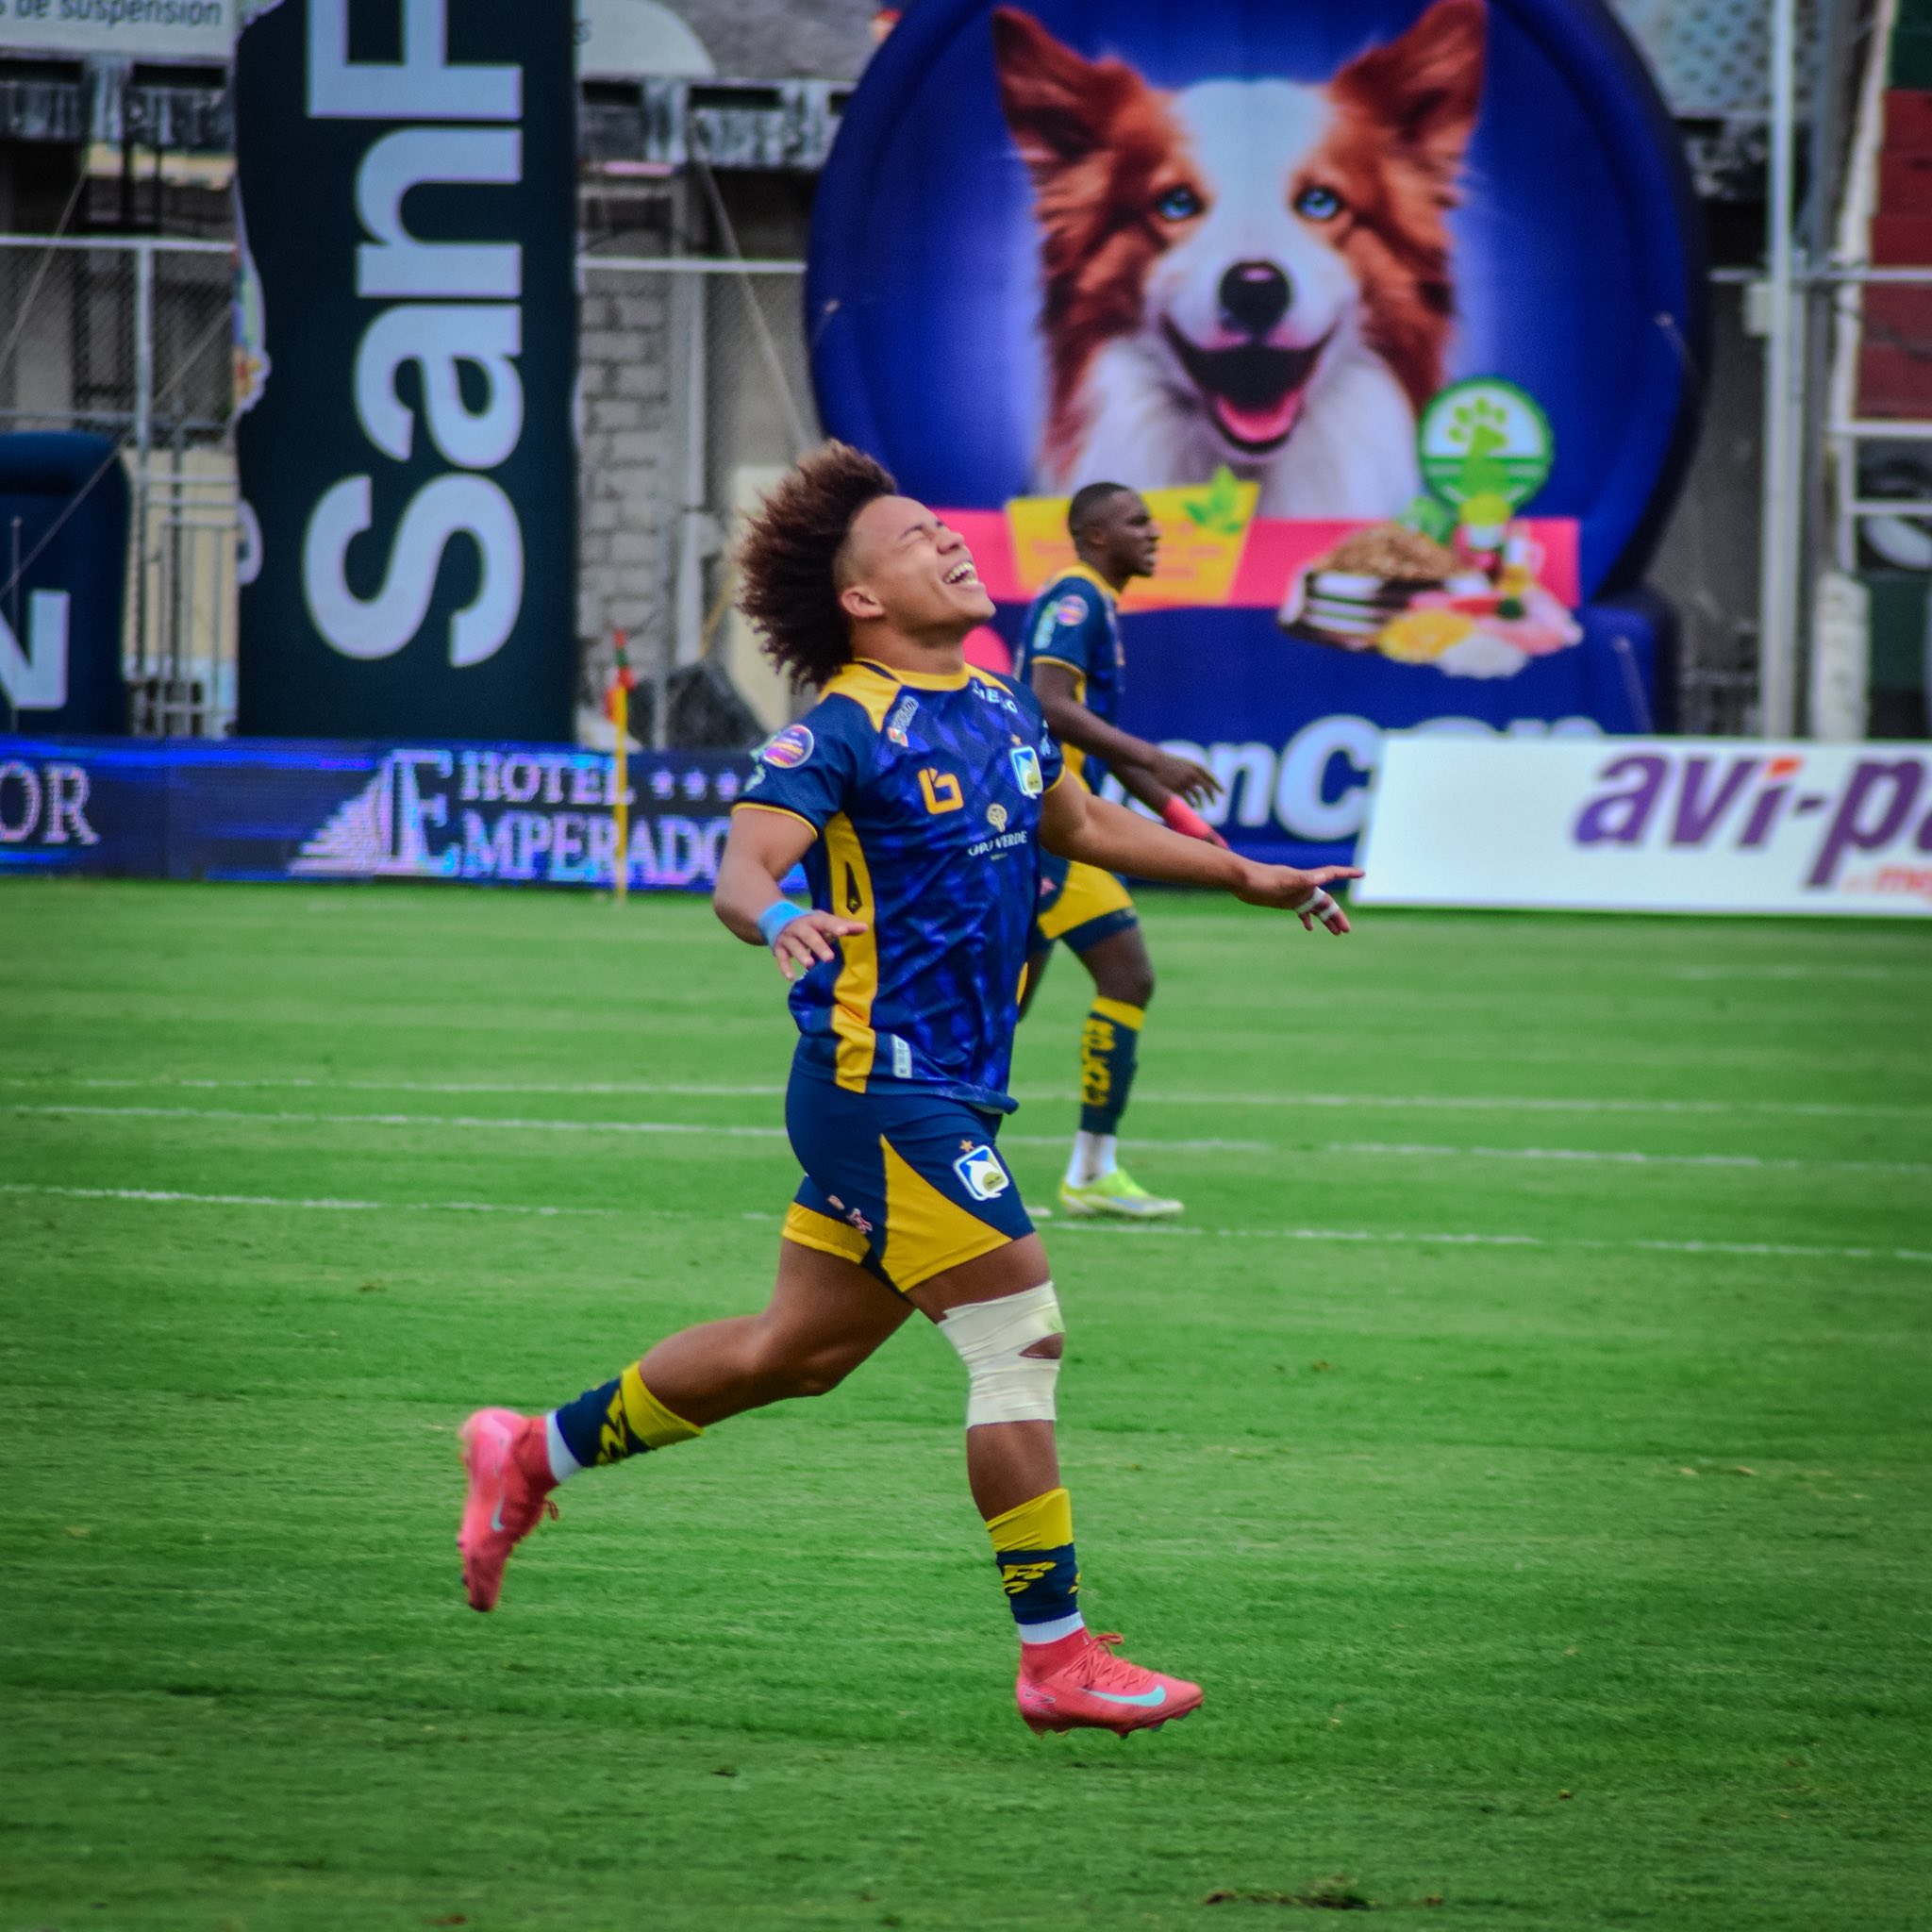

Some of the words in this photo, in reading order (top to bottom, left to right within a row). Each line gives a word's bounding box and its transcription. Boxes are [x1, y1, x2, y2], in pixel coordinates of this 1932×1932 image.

[303, 0, 525, 666] SanF
[458, 750, 637, 807] HOTEL
[1574, 752, 1932, 889] avi-p
